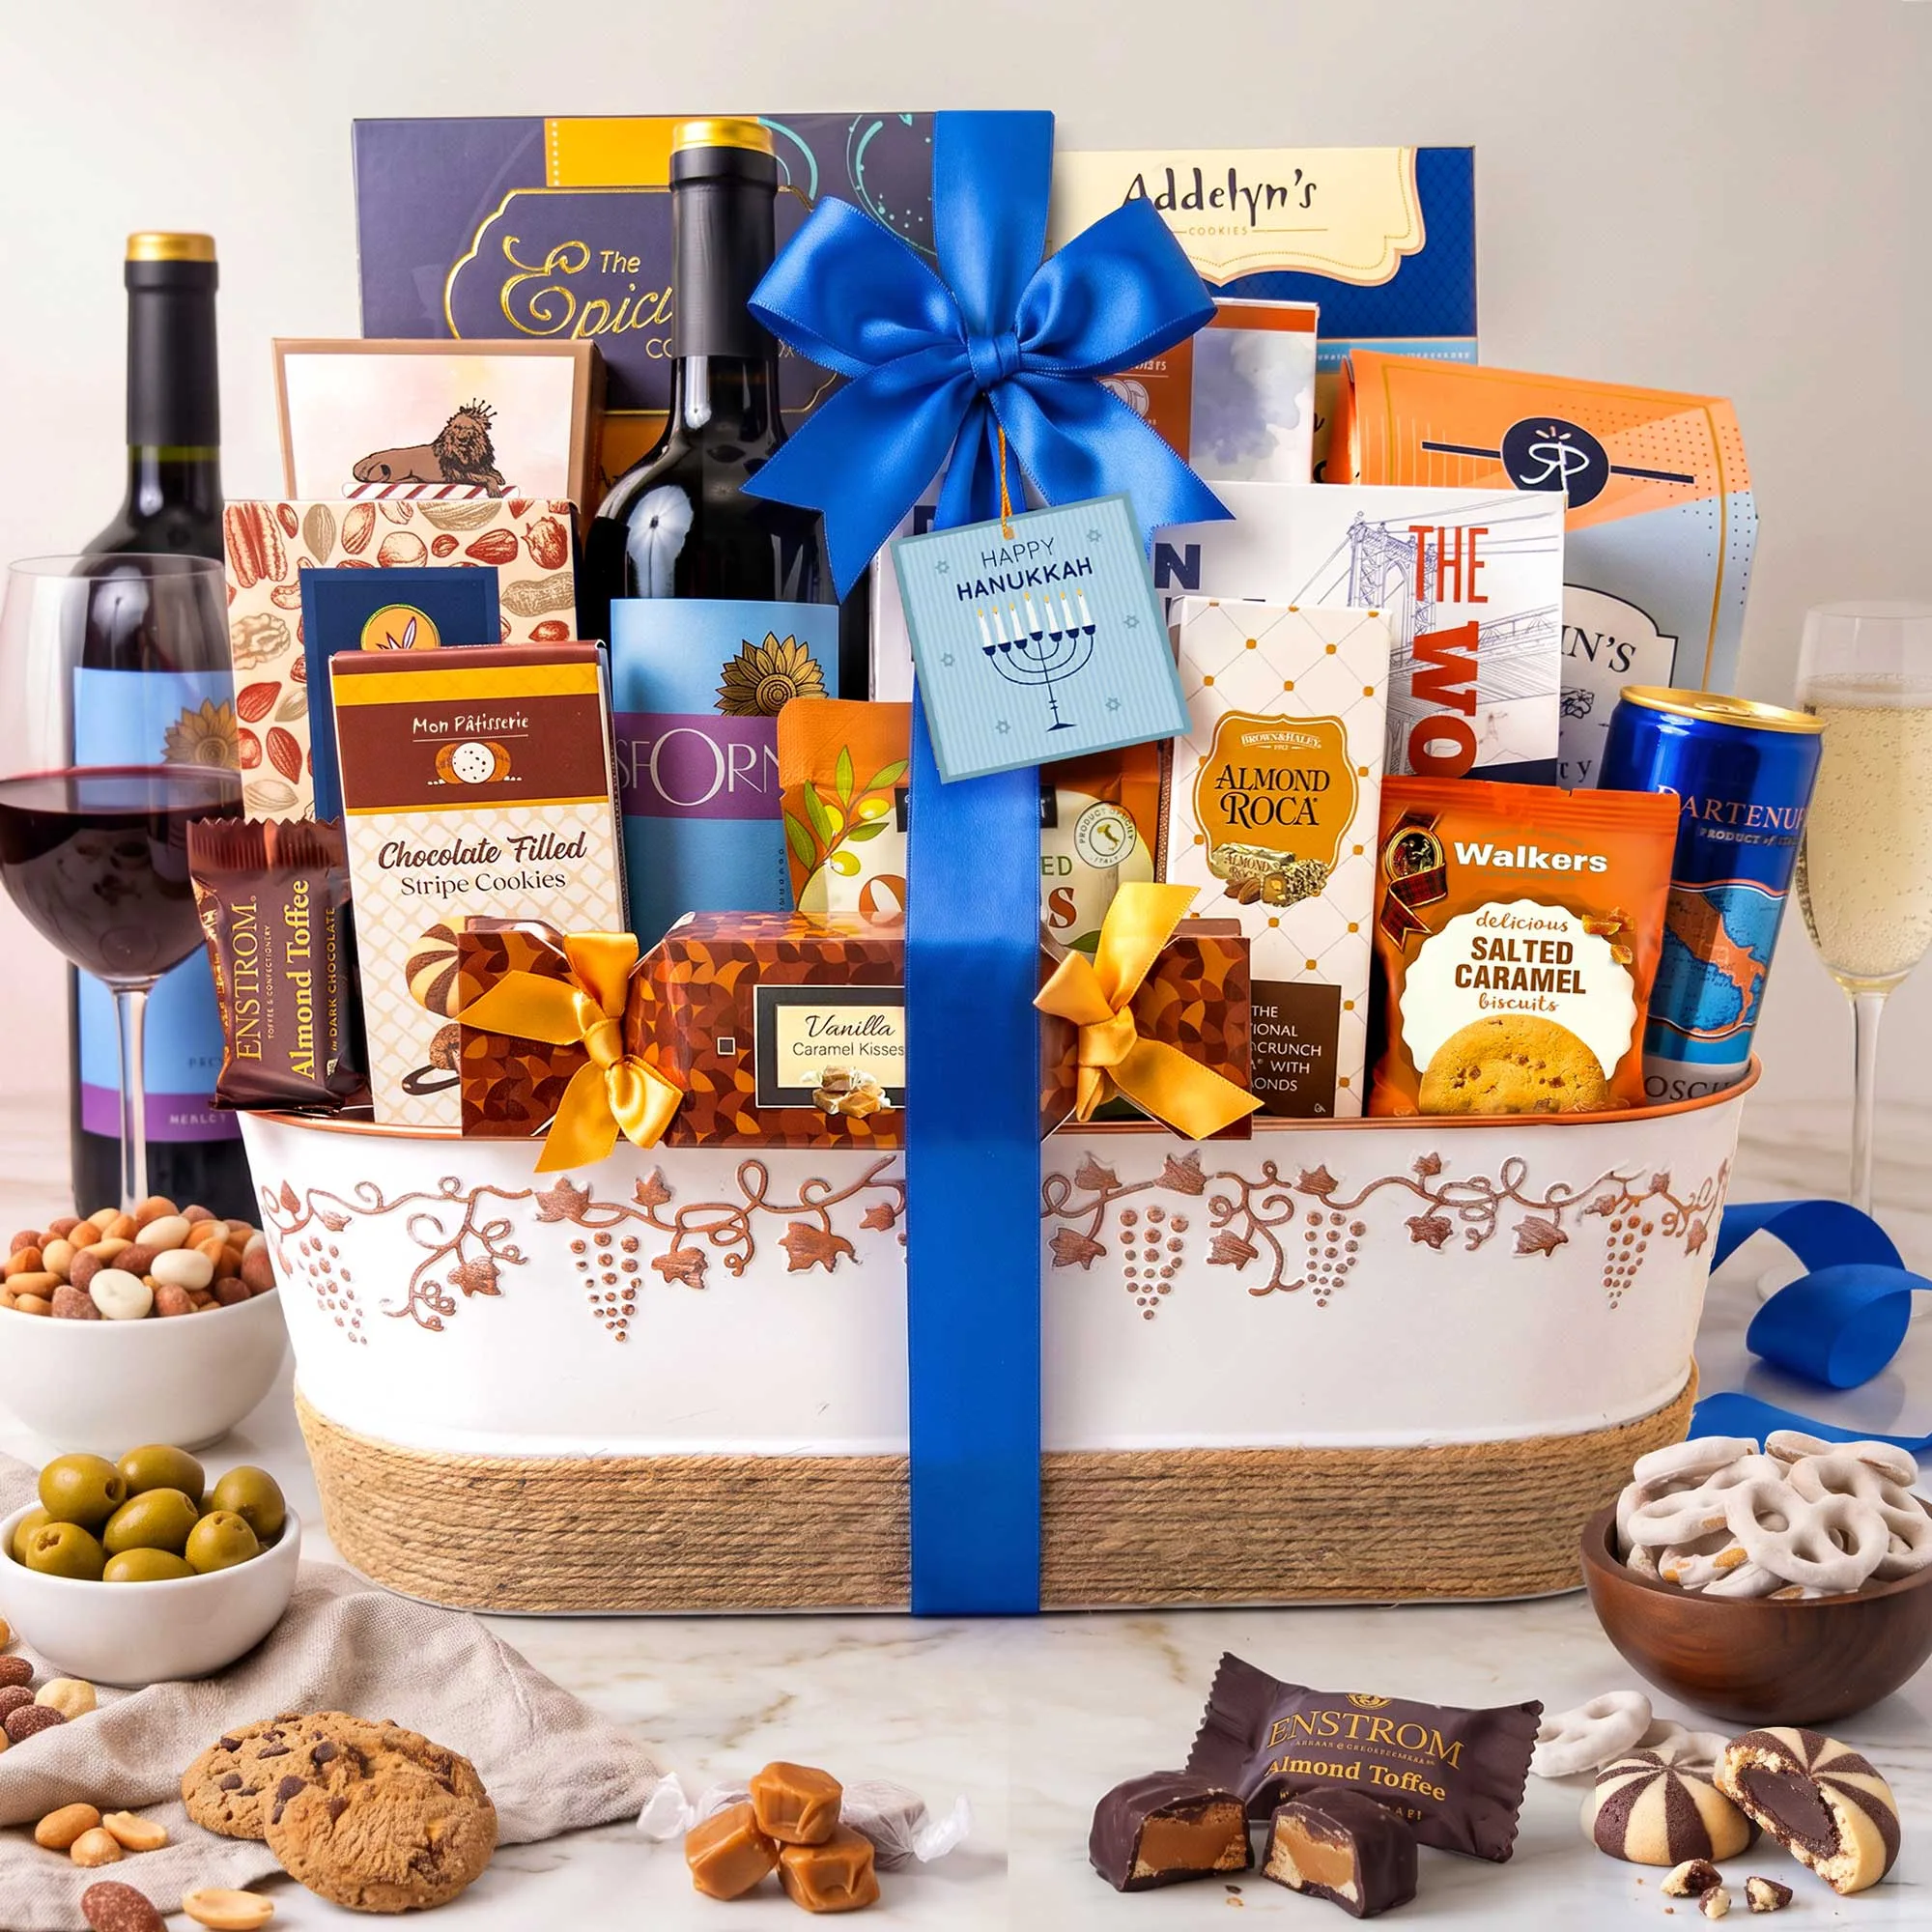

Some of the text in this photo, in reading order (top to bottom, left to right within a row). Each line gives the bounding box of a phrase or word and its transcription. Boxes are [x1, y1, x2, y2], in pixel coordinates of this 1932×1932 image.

[1122, 168, 1317, 227] Addelyn's
[1188, 227, 1248, 236] COOKIES
[600, 249, 640, 274] The
[981, 537, 1055, 569] HAPPY
[1408, 526, 1489, 603] THE
[956, 556, 1094, 601] HANUKKAH
[412, 710, 529, 735] Mon Pâtisserie
[1214, 764, 1330, 792] ALMOND
[1658, 784, 1804, 830] ARTENU
[378, 831, 588, 869] Chocolate Filled
[1700, 827, 1760, 845] PRODUCT
[1454, 841, 1608, 874] Walkers
[401, 870, 567, 899] Stripe Cookies
[1476, 911, 1569, 933] delicious
[326, 907, 337, 993] CHOCOLATE
[1471, 936, 1574, 965] SALTED
[231, 902, 263, 1062] ENSTROM
[284, 880, 315, 1080] Almond Toffee
[1454, 964, 1587, 995] CARAMEL
[327, 998, 338, 1037] DARK
[1252, 1006, 1278, 1018] THE
[1479, 992, 1561, 1013] biscuits
[805, 1014, 895, 1037] Vanilla
[793, 1042, 904, 1056] Caramel Kisses
[1270, 1062, 1310, 1074] WITH
[1251, 1077, 1297, 1092] ONDS
[1266, 1710, 1464, 1771] ENSTROM
[1265, 1754, 1446, 1801] Almond Toffee
